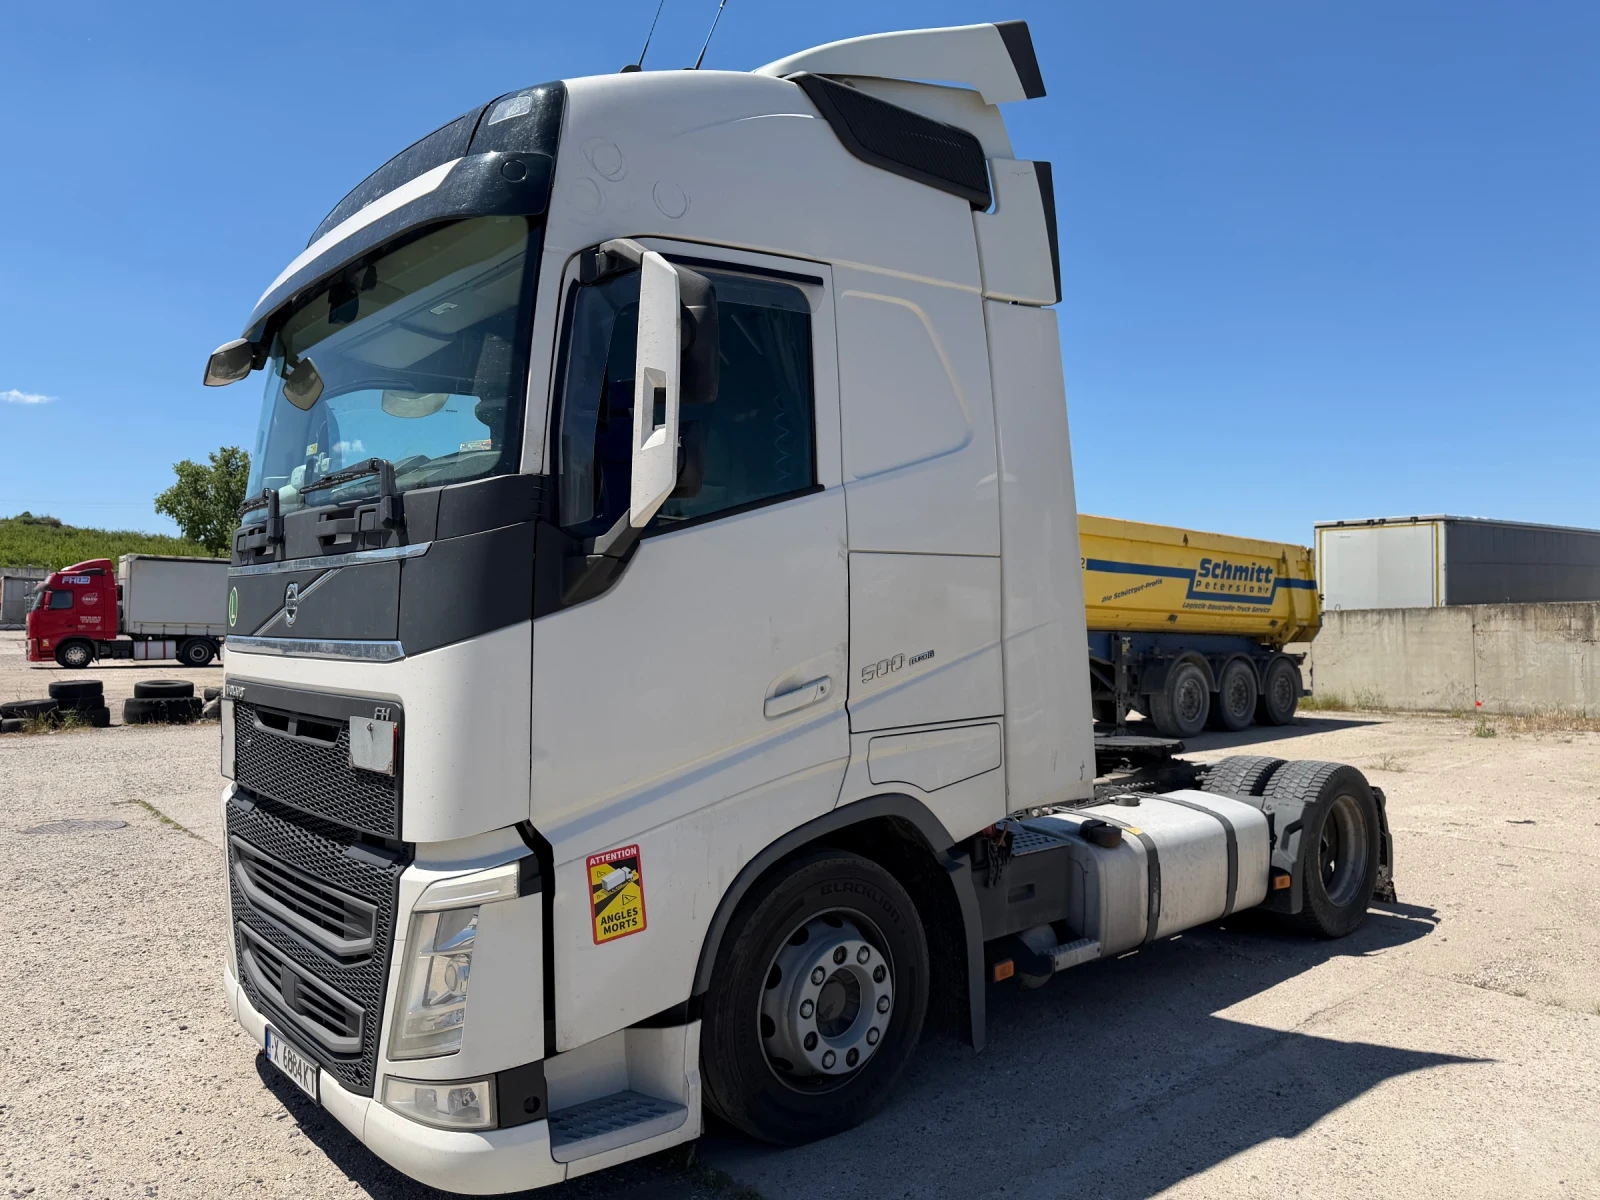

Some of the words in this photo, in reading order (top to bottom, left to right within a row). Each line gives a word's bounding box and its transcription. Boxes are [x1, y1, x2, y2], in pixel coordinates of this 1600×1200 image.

[1198, 558, 1273, 583] Schmitt
[1101, 595, 1113, 603] Die
[861, 652, 905, 684] 500
[374, 706, 391, 720] FH
[590, 846, 637, 866] ATTENTION
[601, 907, 639, 926] ANGLES
[603, 917, 638, 935] MORTS
